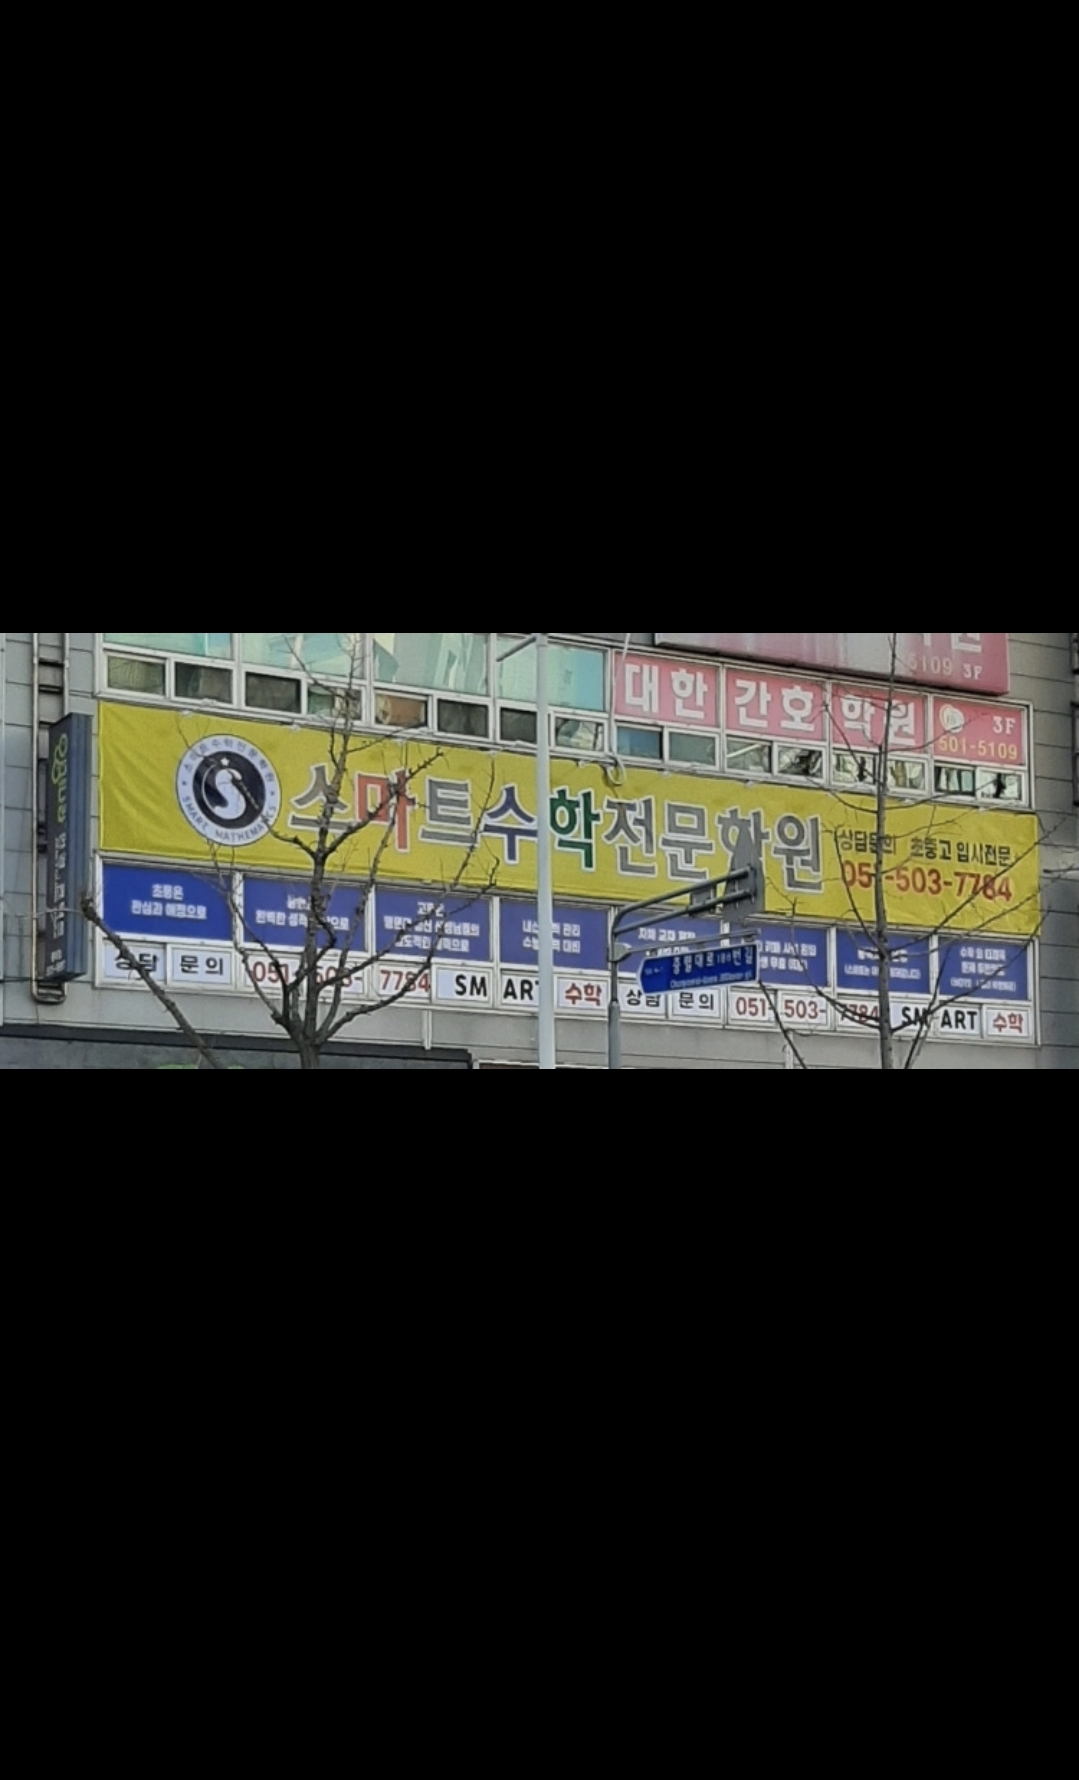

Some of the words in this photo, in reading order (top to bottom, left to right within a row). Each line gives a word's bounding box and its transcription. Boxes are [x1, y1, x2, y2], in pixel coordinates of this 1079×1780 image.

[963, 662, 982, 680] 3F
[625, 663, 708, 720] 대한
[734, 679, 815, 732] 간호
[840, 694, 916, 746] 학원
[993, 716, 1016, 735] 3F
[938, 736, 1018, 761] 501-5109
[843, 860, 1012, 902] 05-503-7784
[180, 955, 224, 976] 문의
[503, 978, 540, 1002] AR
[565, 982, 603, 1007] 수학
[679, 991, 715, 1011] 문의
[840, 1004, 880, 1024] 784
[941, 1009, 978, 1031] ART
[992, 1012, 1024, 1034] 수학
